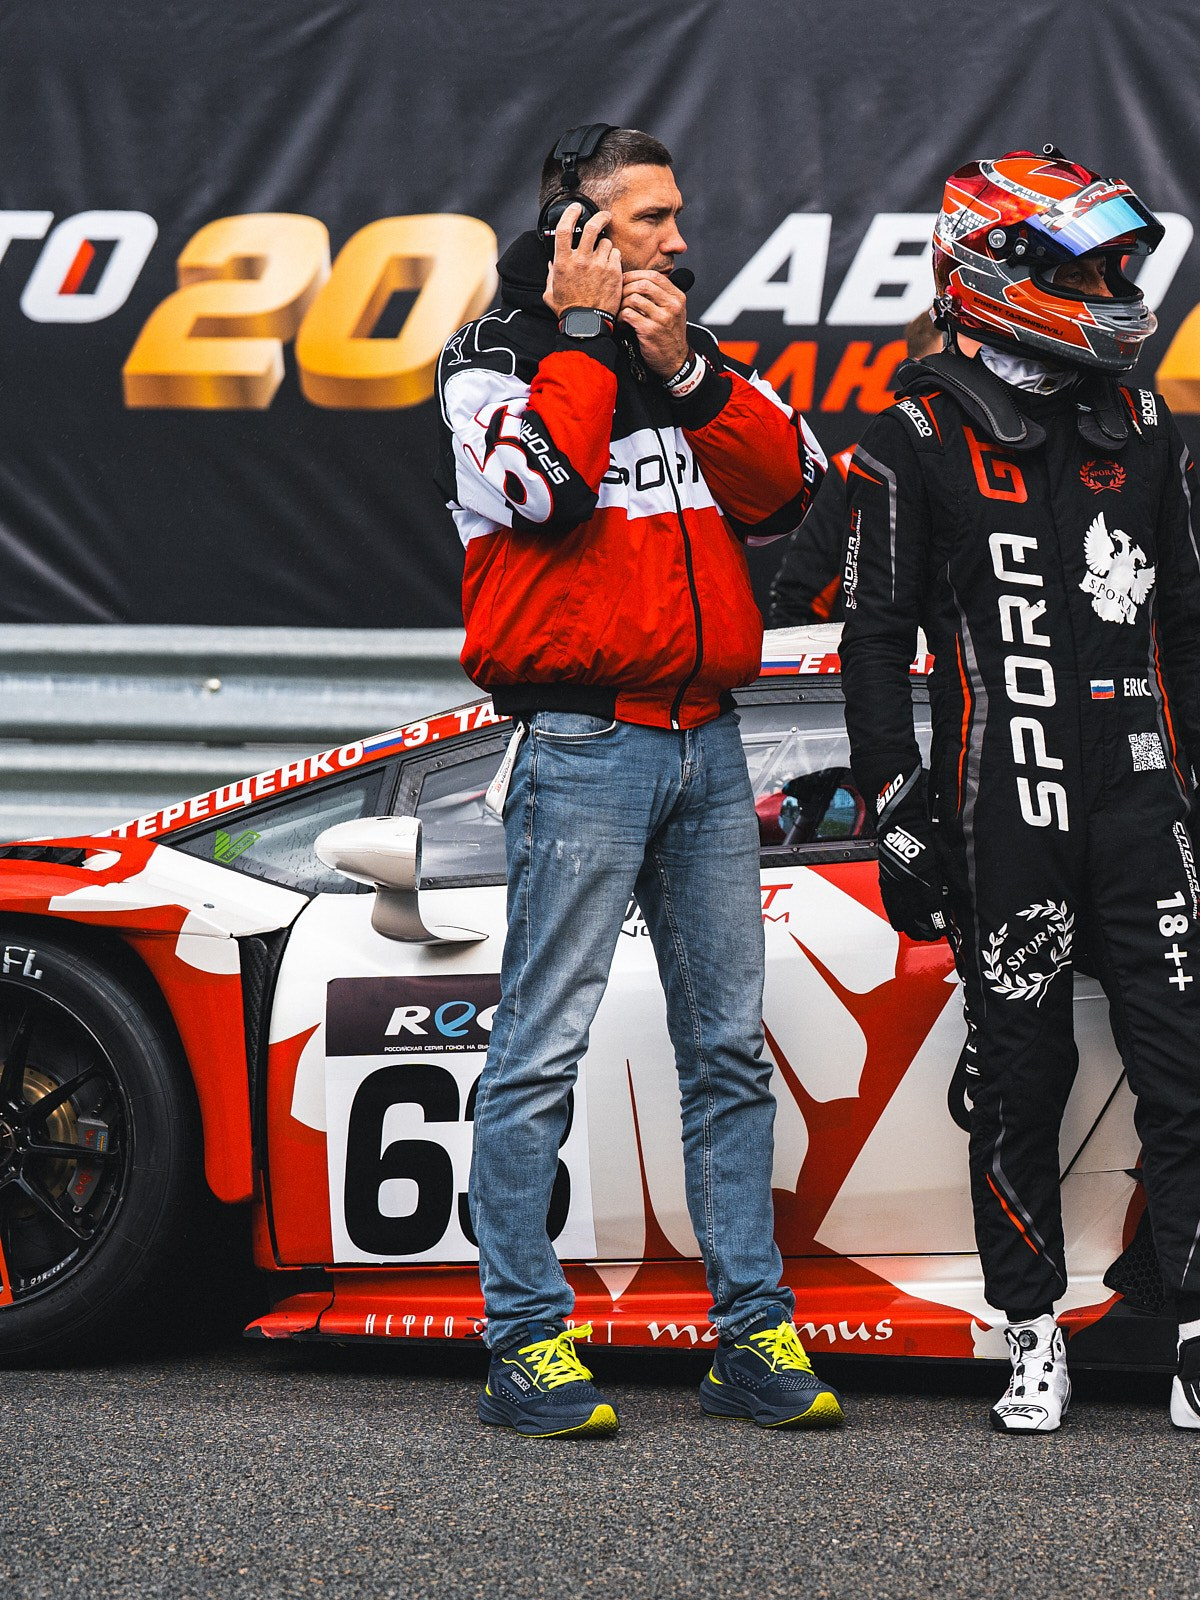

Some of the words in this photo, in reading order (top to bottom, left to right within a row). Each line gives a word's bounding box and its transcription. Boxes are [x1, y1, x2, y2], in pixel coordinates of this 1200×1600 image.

[704, 212, 1194, 326] АВ
[122, 212, 499, 410] 20
[972, 296, 1003, 317] ERNEST
[1004, 309, 1065, 338] TARONISHVILI
[717, 340, 909, 415] ЛЮ
[1089, 468, 1117, 479] SPORA
[988, 532, 1070, 832] SPORA
[1123, 677, 1152, 697] ERIC
[110, 741, 364, 838] ТЕРЕЩЕНКО
[403, 721, 440, 748] Э.
[453, 700, 513, 733] ТА
[885, 829, 922, 860] OMP
[932, 911, 946, 930] OMP
[1156, 890, 1194, 992] 18++
[1005, 924, 1058, 973] SPORA
[364, 1313, 455, 1338] НЕФРО
[647, 1318, 894, 1345] mamus
[511, 1371, 532, 1391] sparco
